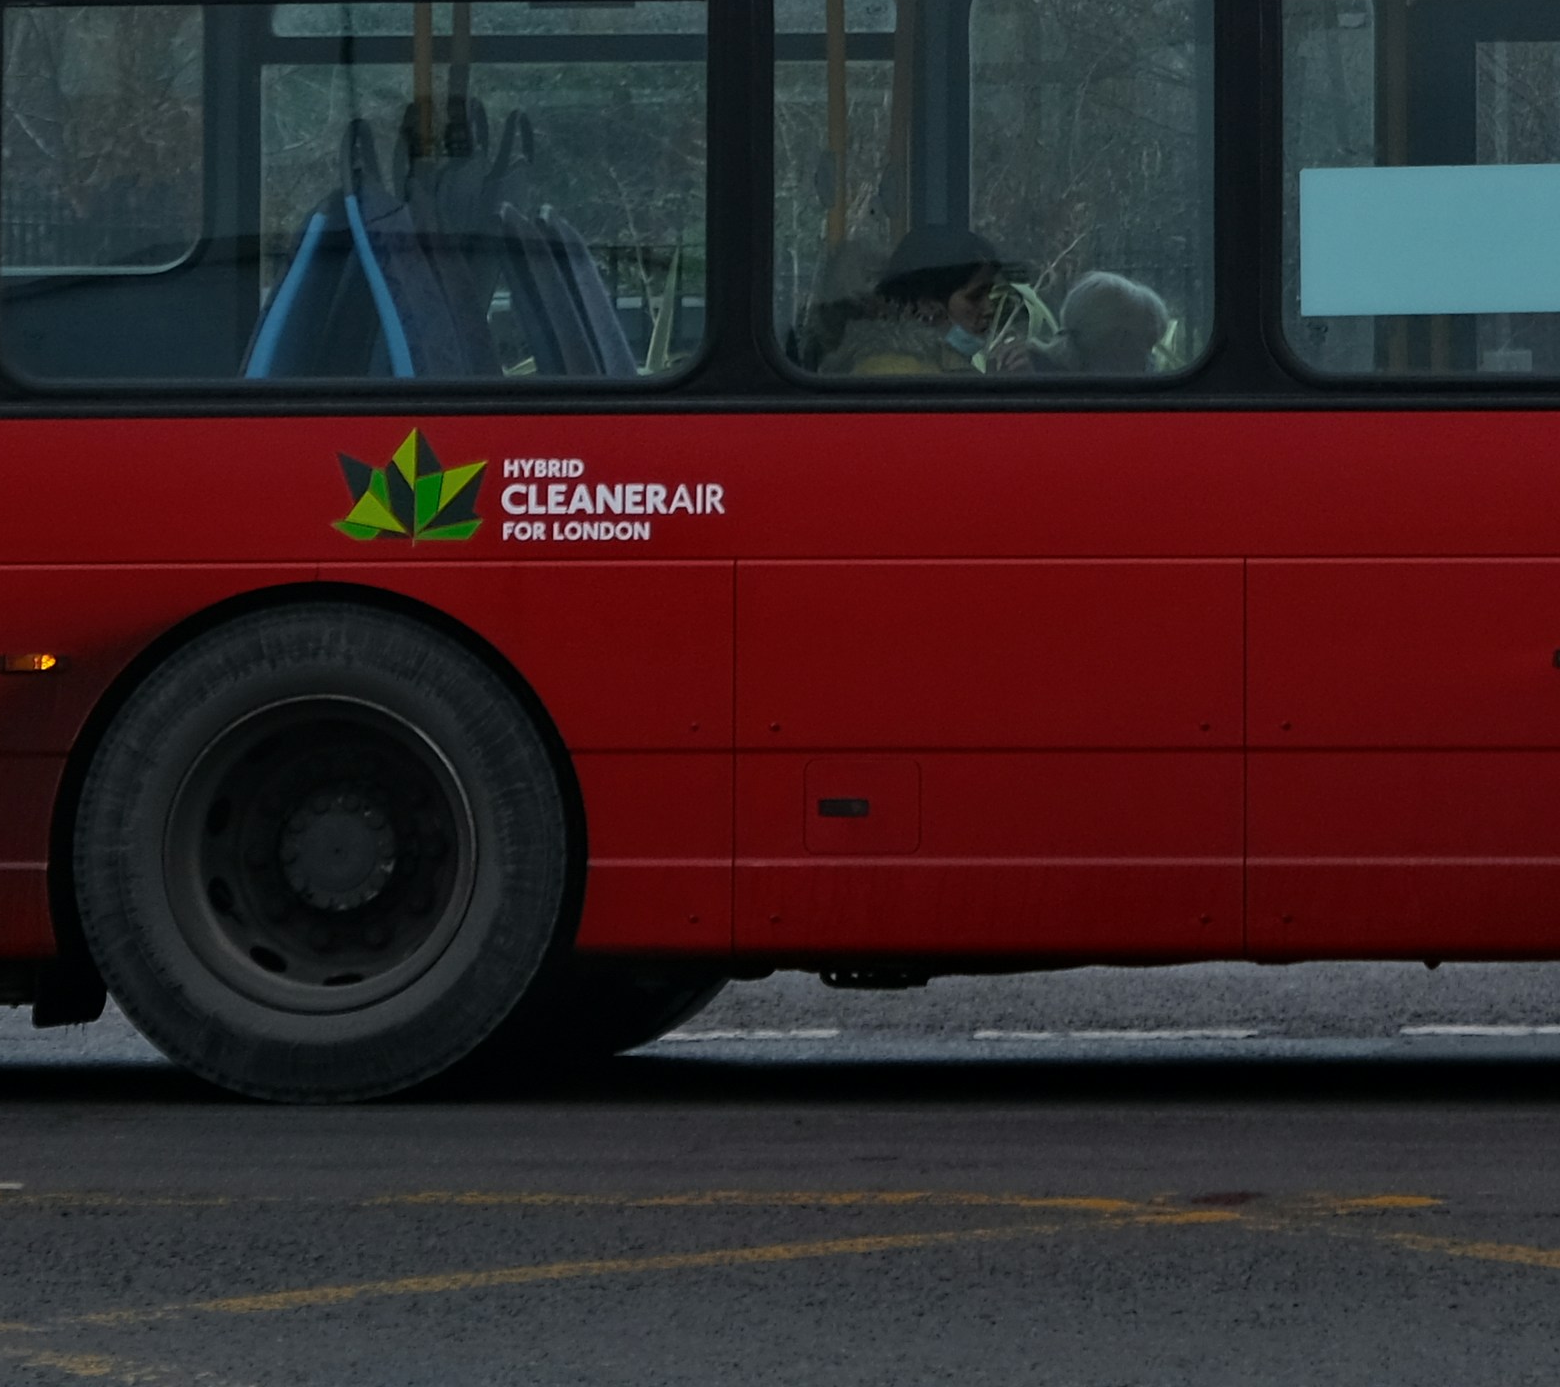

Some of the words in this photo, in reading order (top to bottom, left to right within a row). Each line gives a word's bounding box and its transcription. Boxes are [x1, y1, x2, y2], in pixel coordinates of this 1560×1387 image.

[502, 459, 585, 479] HYBRID
[500, 483, 726, 516] CLEANERAIR
[502, 521, 547, 542] FOR
[552, 521, 651, 542] LONDON
